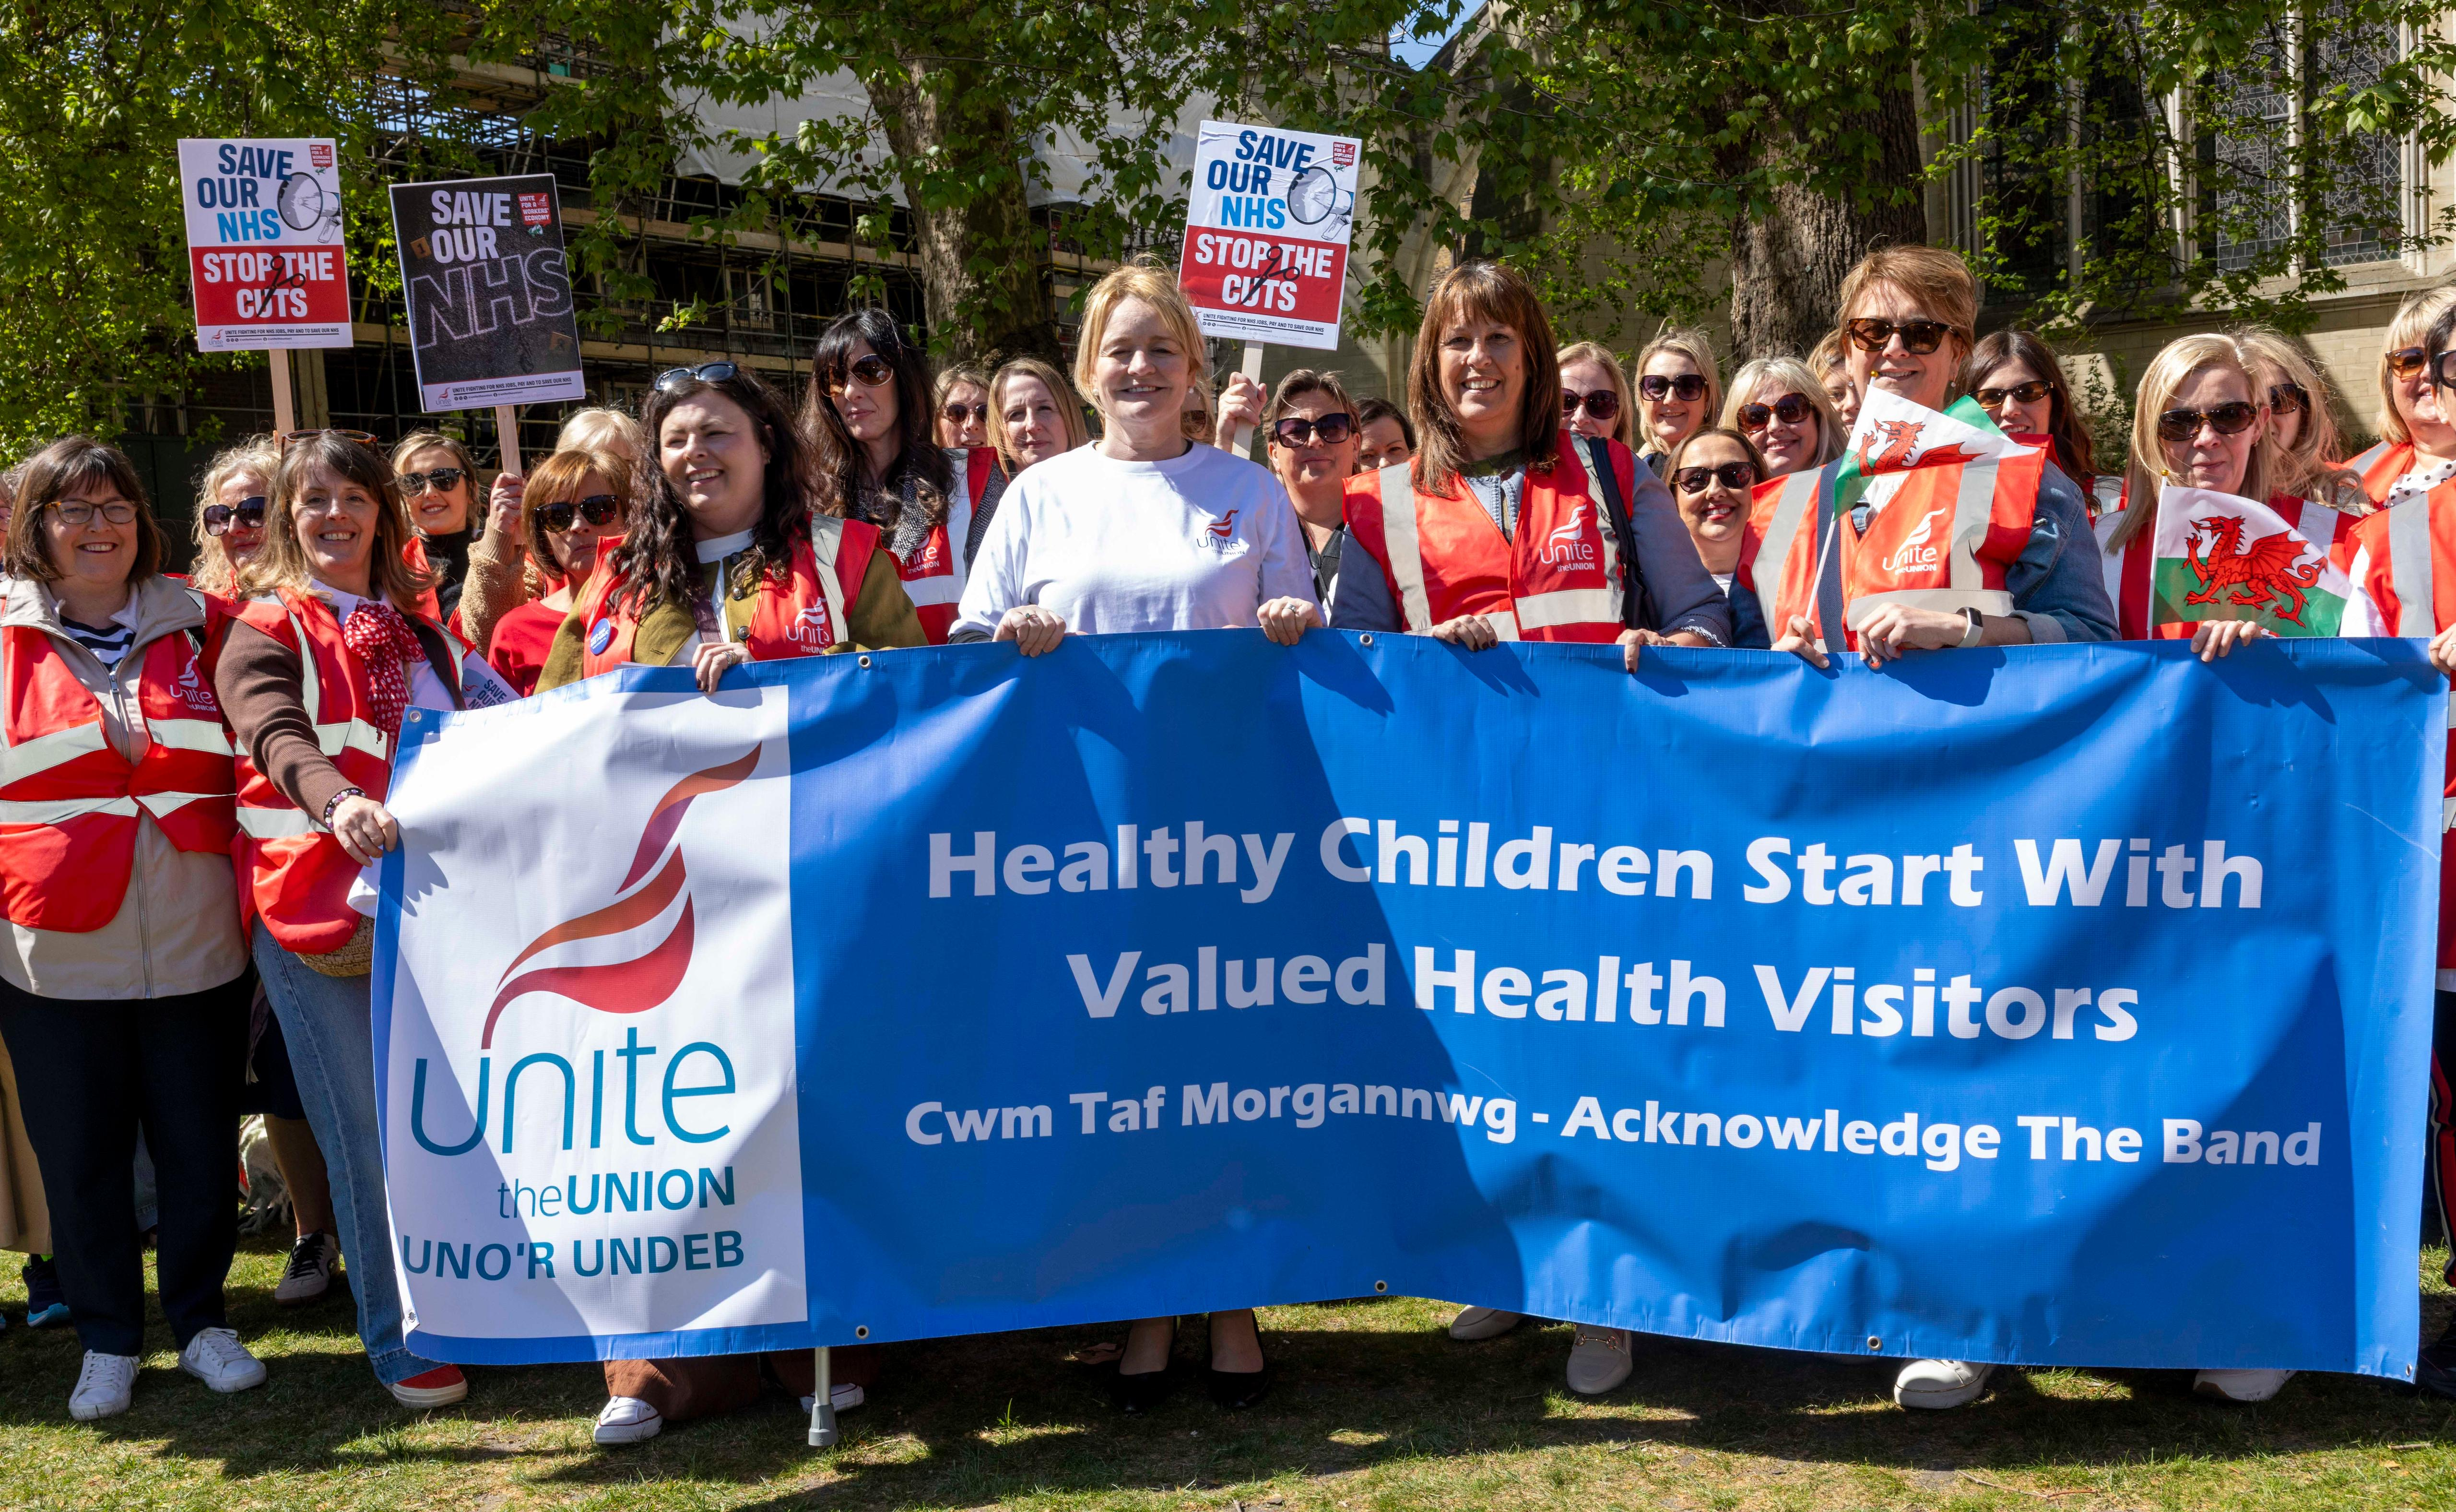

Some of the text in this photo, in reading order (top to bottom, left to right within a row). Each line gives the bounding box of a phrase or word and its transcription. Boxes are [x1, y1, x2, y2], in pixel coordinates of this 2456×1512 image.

[218, 144, 293, 181] SAVE
[1235, 130, 1315, 175] SAVE
[198, 177, 260, 208] OUR
[1207, 160, 1271, 196] OUR
[217, 209, 281, 242] NHS
[432, 190, 511, 226] SAVE
[1221, 196, 1286, 229] NHS
[432, 226, 499, 263] OUR
[1195, 234, 1334, 279] STOP THE
[203, 252, 334, 283] STOP THE
[236, 288, 307, 318] CUTS
[410, 248, 574, 349] NHS
[1222, 274, 1298, 312] CUTS
[906, 546, 937, 567] nite
[908, 560, 940, 574] theUNION
[1558, 562, 1595, 572] theUNION
[484, 679, 507, 703] SAVE
[929, 817, 2264, 909] Healthy Children Start With
[1066, 942, 2139, 1042] Valued Health Visitors
[905, 1081, 2320, 1172] Cwm Taf Morgannwg - Acknowledge The Band
[497, 1165, 735, 1218] theUNION
[403, 1229, 744, 1281] UNO'R UNDEB
